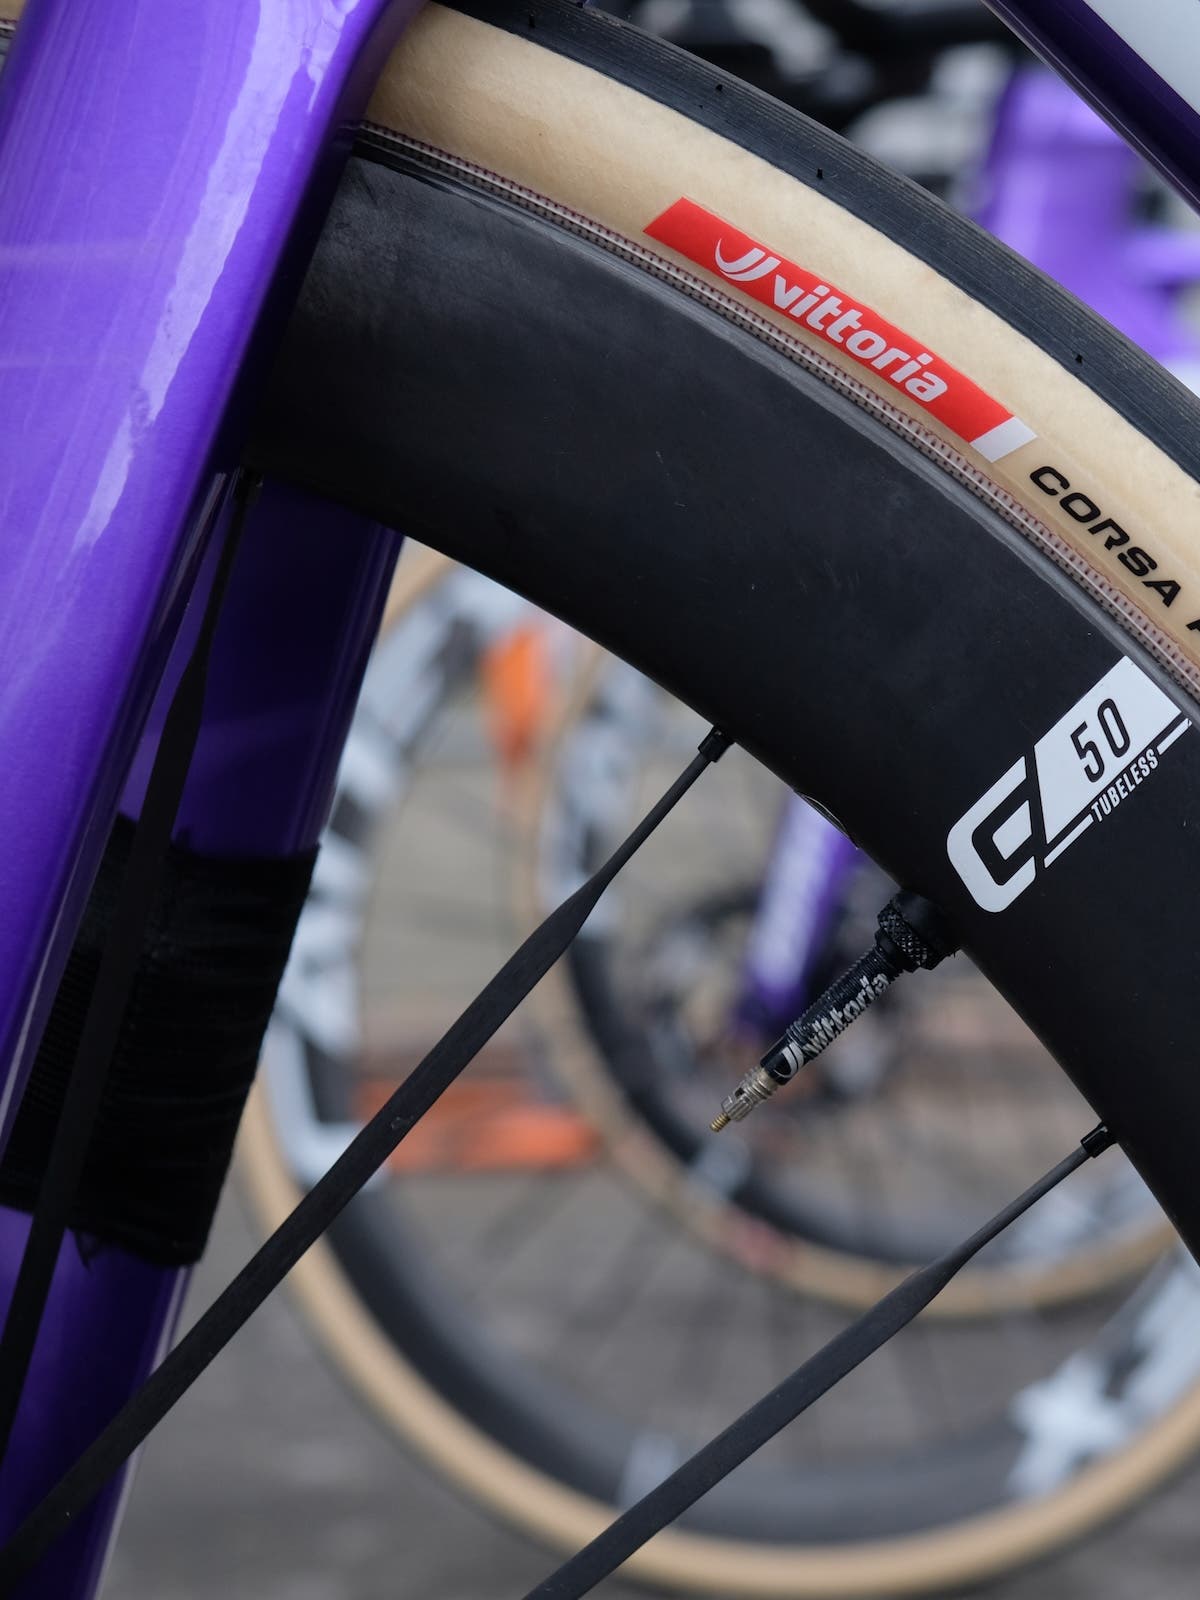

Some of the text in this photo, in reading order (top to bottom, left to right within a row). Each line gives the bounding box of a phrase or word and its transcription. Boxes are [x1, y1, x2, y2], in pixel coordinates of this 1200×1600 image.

[772, 273, 948, 403] vittoria
[1029, 465, 1181, 608] CORSA
[1070, 698, 1131, 783] 50
[1091, 748, 1158, 823] TUBELESS
[802, 972, 890, 1055] vittoria
